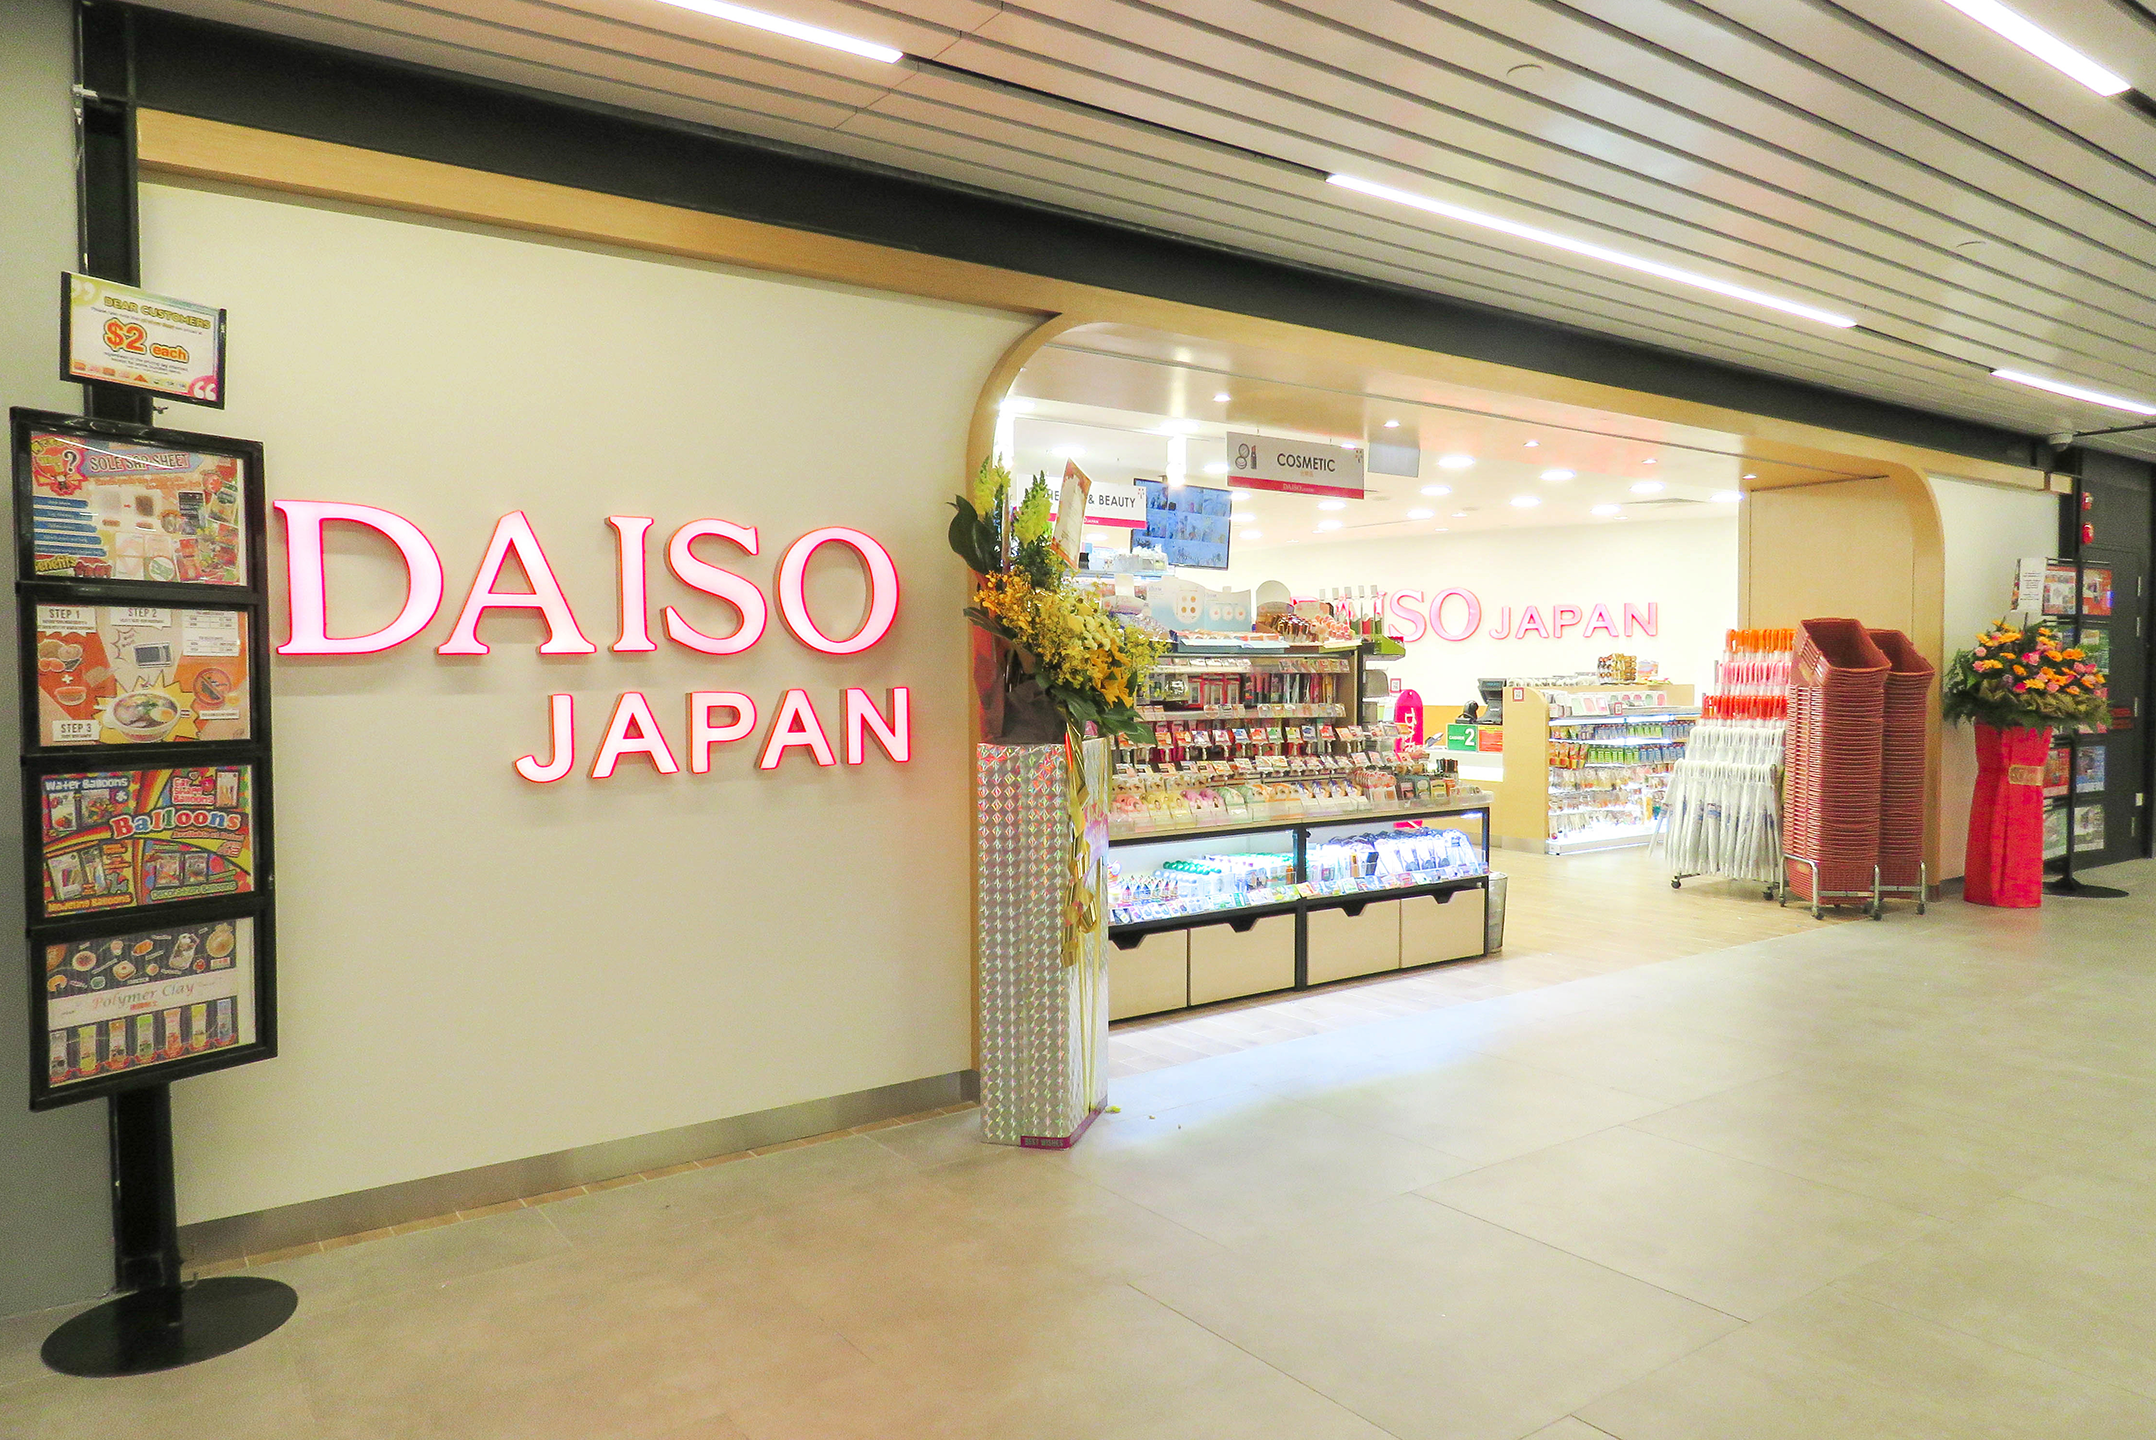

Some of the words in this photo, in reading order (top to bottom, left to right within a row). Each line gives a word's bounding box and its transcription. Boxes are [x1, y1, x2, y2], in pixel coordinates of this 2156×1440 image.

[104, 296, 138, 313] DEAR
[140, 305, 211, 329] CUSTOMERS
[105, 319, 146, 352] $2
[151, 344, 187, 362] each
[90, 455, 122, 471] SOLE
[152, 453, 189, 467] SHEET
[1277, 453, 1336, 473] COSMETIC
[1088, 494, 1095, 505] &
[1098, 494, 1136, 508] BEAUTY
[272, 499, 900, 656] DAISO
[49, 609, 72, 619] STEP
[76, 610, 80, 619] 1
[128, 607, 150, 618] STEP
[152, 608, 157, 618] 2
[1489, 602, 1658, 640] JAPAN
[61, 723, 83, 733] STEP
[86, 723, 92, 733] 3
[513, 686, 911, 784] JAPAN
[1465, 728, 1475, 746] 2
[45, 779, 80, 791] Water
[82, 776, 128, 789] Balloons
[110, 808, 242, 839] Balloons
[92, 988, 157, 1007] Polymer
[162, 981, 195, 997] Clay
